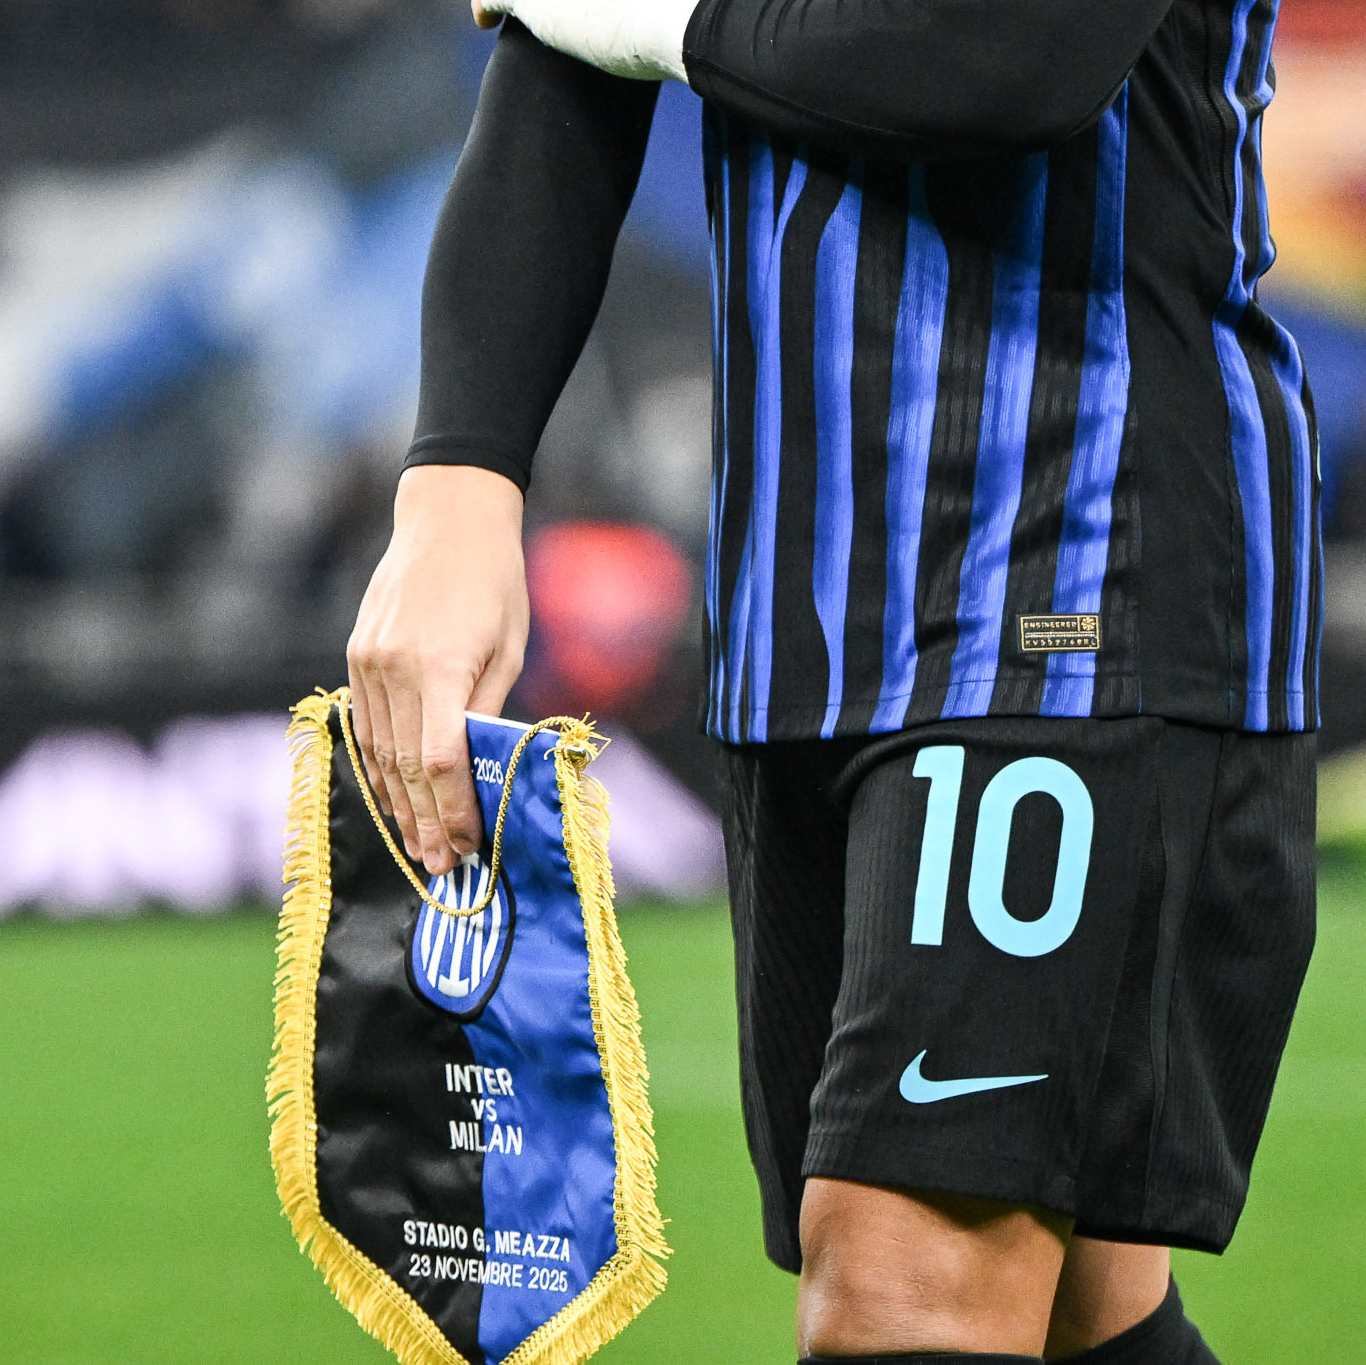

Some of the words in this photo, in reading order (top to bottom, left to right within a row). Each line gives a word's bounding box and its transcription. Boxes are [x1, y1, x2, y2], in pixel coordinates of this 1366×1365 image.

[911, 745, 1094, 958] 10
[445, 1063, 515, 1097] INTER
[470, 1098, 498, 1122] VS
[448, 1120, 523, 1156] MILAN
[403, 1219, 468, 1250] STADIO
[472, 1228, 491, 1253] G.
[495, 1230, 571, 1263] MEAZZA
[408, 1253, 432, 1278] 23
[434, 1255, 524, 1288] NOVEMBRE
[527, 1266, 569, 1293] 2025
